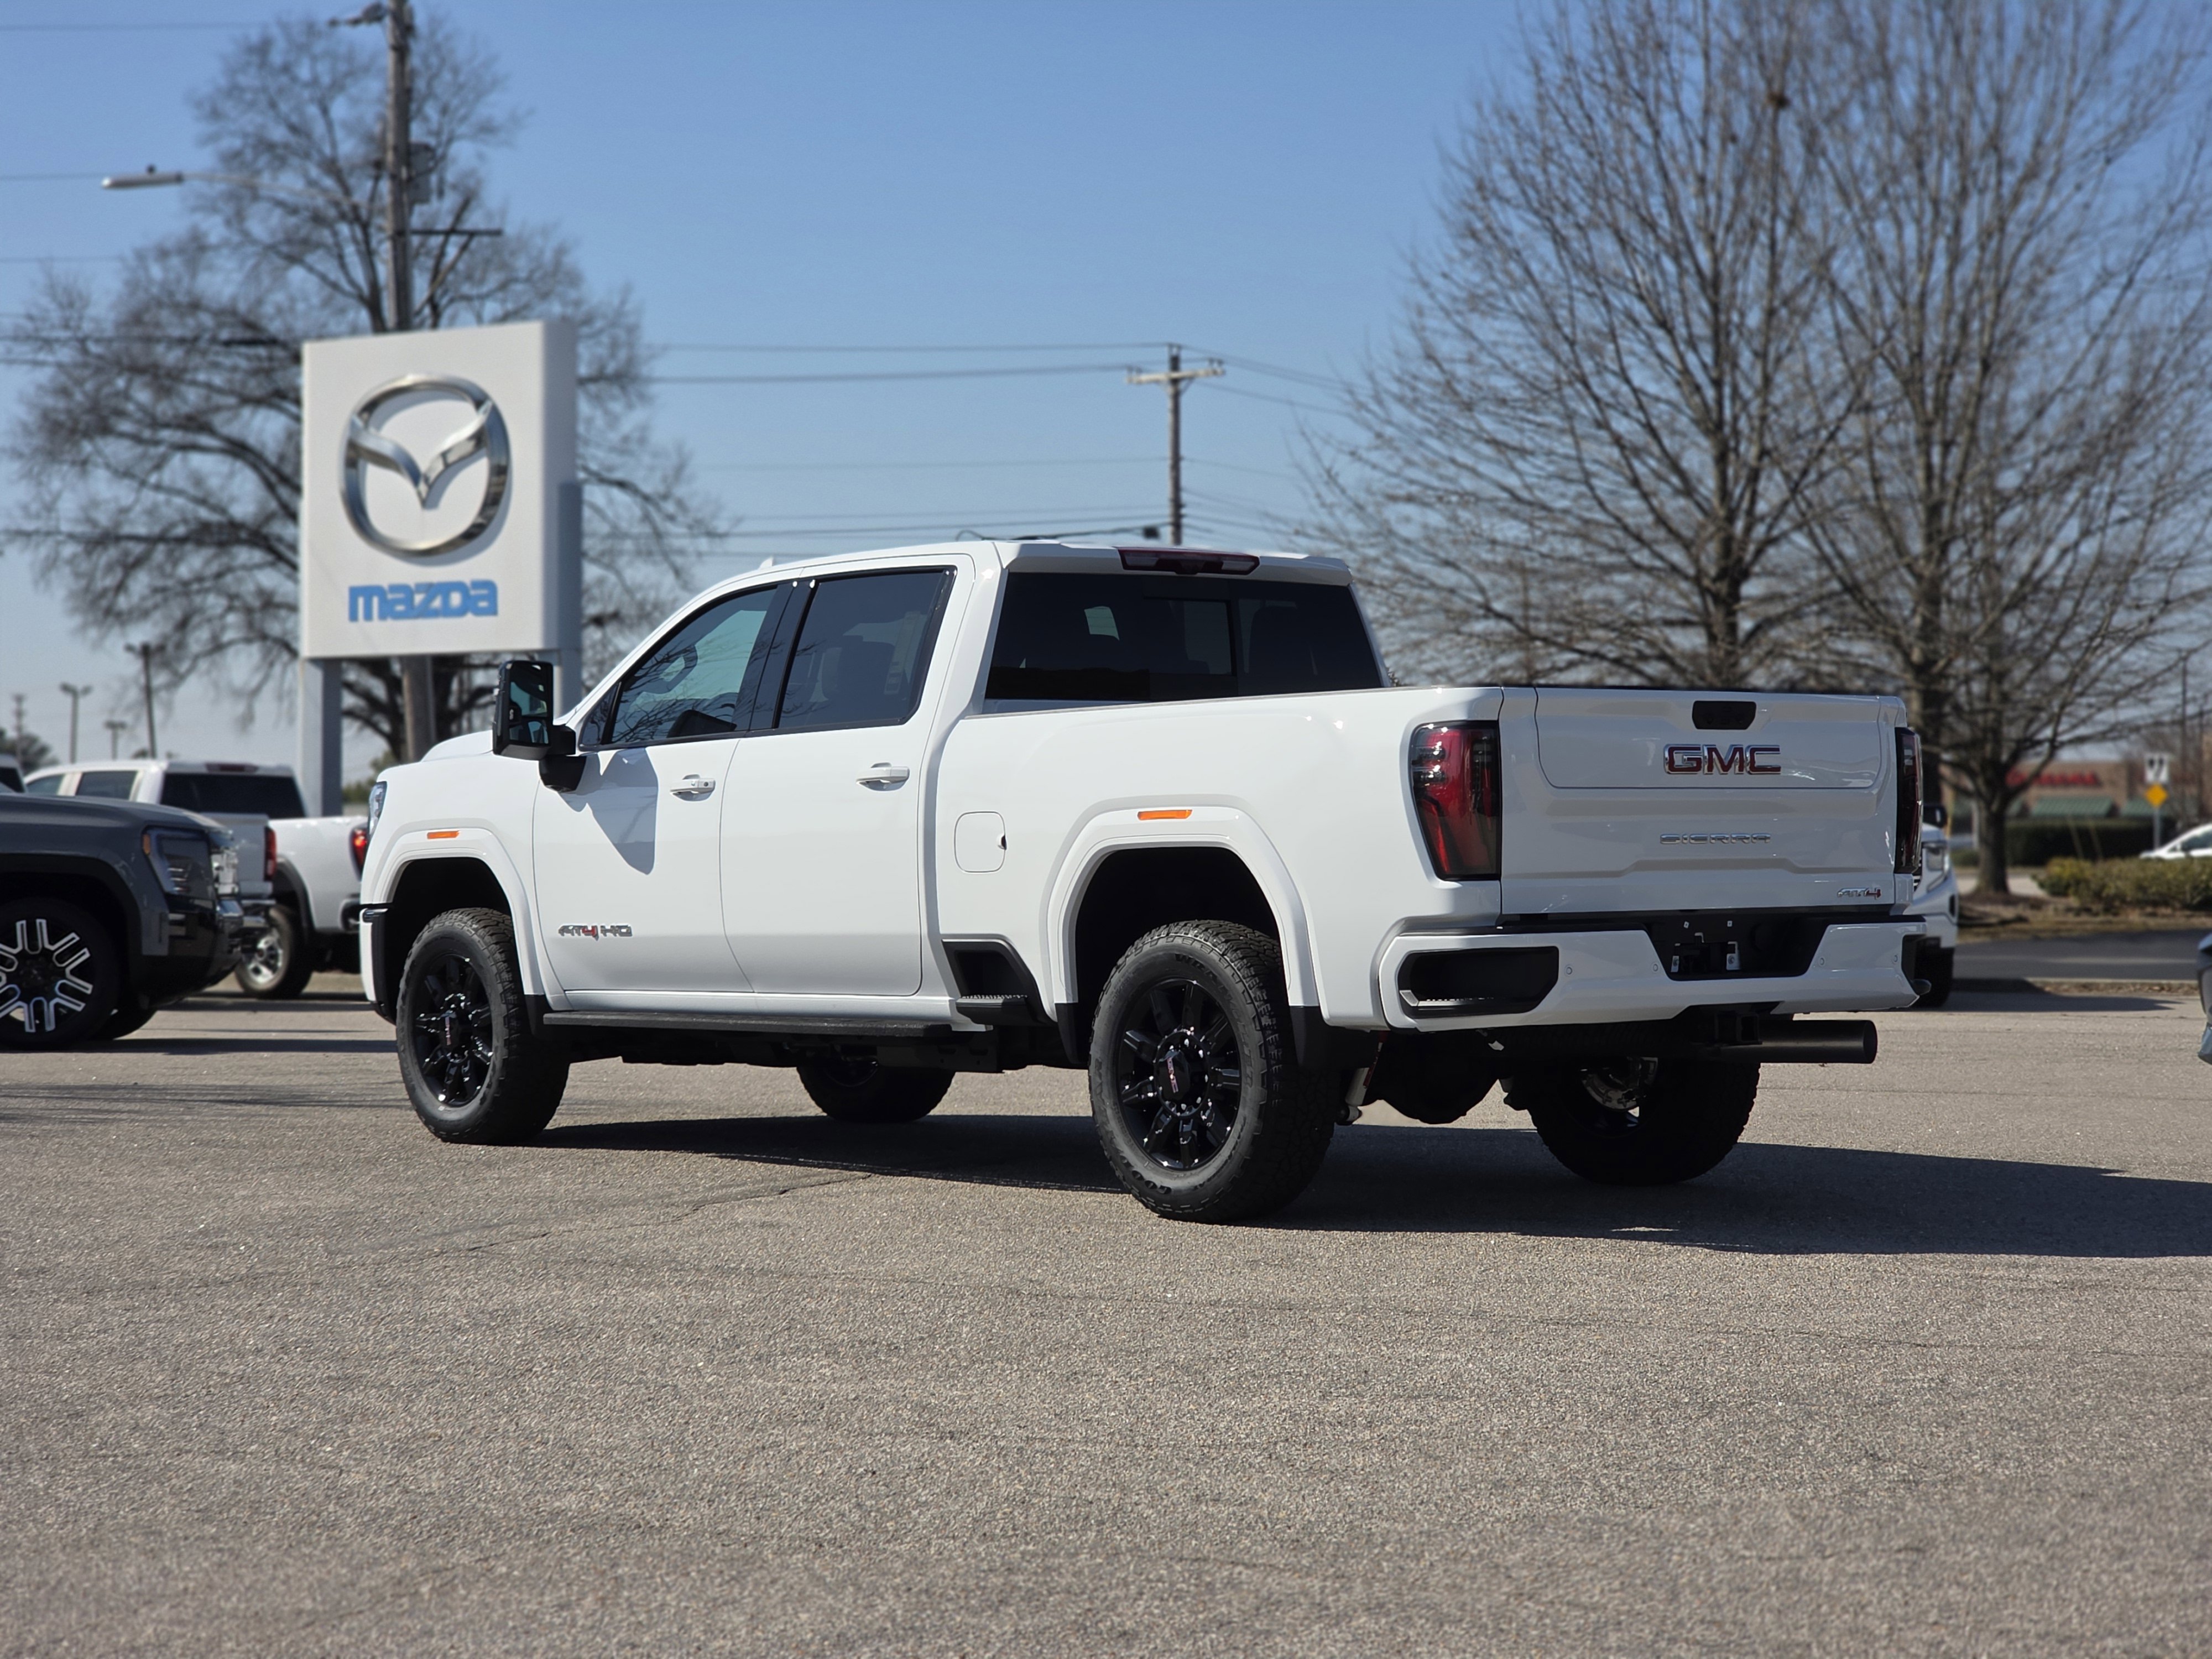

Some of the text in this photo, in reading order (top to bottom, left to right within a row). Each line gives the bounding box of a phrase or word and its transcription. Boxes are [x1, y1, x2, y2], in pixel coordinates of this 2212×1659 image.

[1664, 744, 1781, 774] GMC
[1661, 833, 1770, 844] SIERRA
[1837, 887, 1881, 900] AT4
[558, 925, 633, 941] AT4 HD
[1094, 1057, 1172, 1195] GOODYEAR
